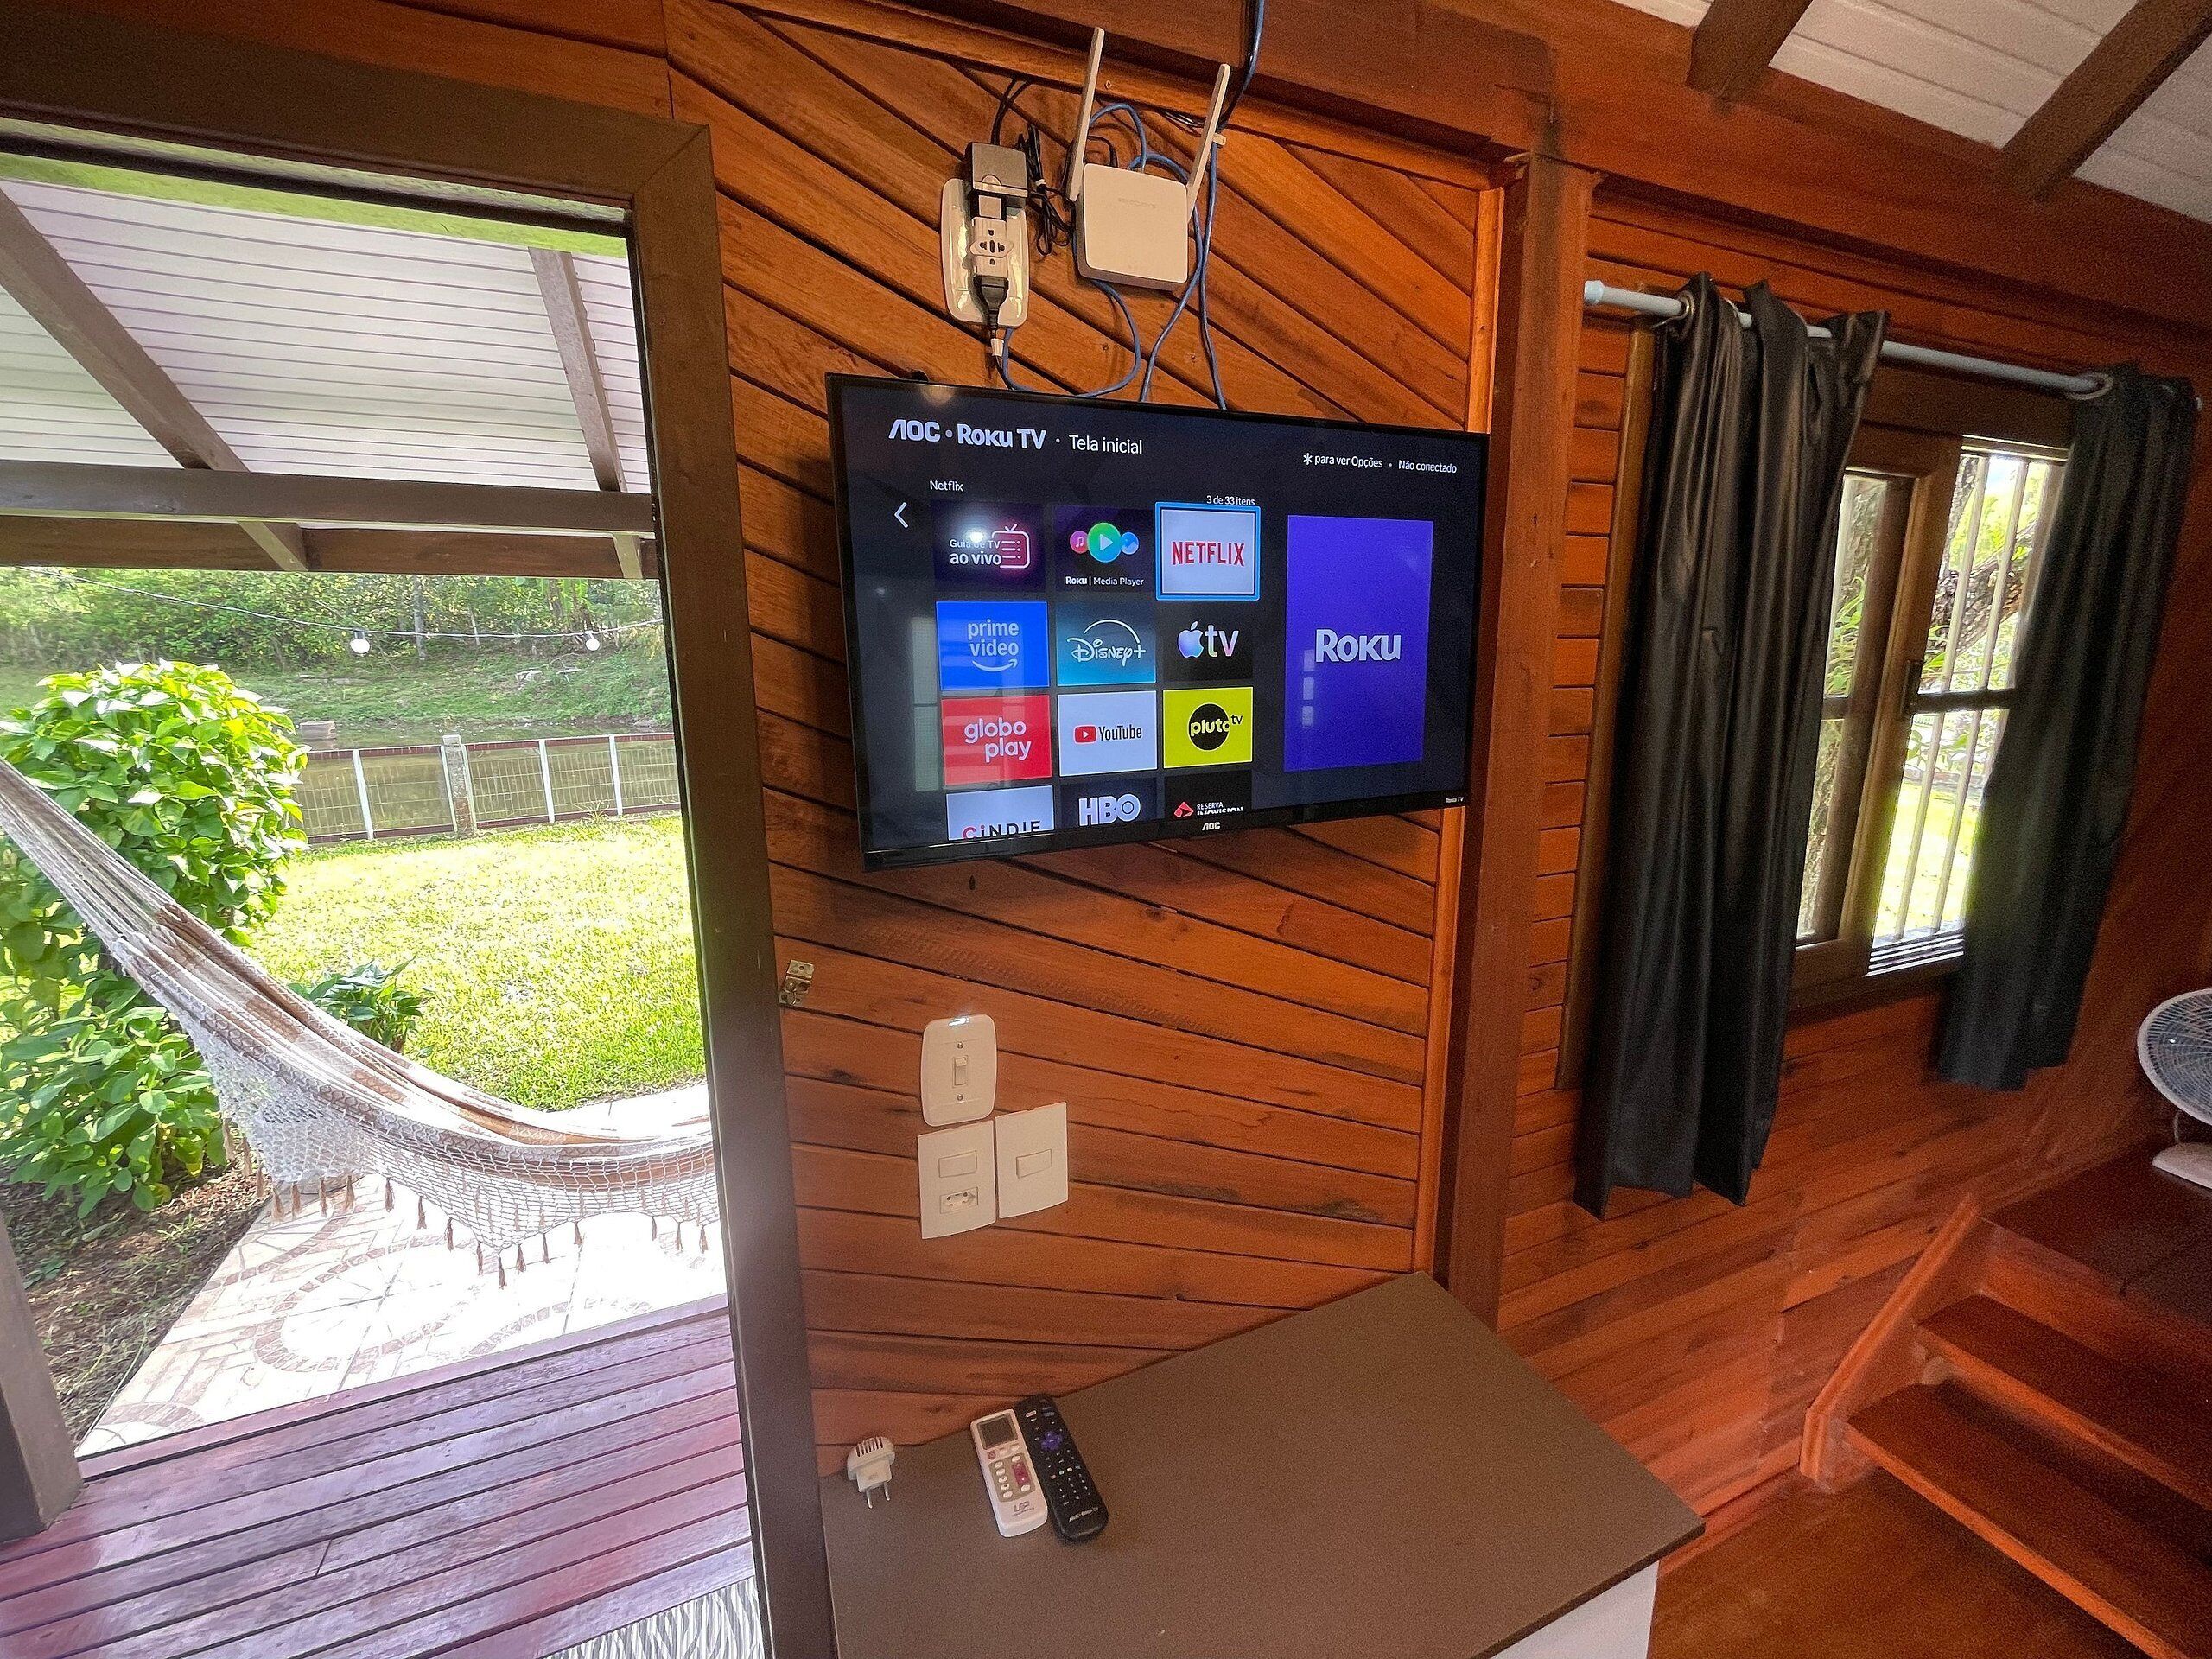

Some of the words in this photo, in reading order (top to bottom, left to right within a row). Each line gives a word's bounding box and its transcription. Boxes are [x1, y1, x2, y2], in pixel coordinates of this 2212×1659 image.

[957, 423, 1013, 448] Roku
[1016, 428, 1047, 449] TV
[1069, 434, 1098, 452] Tela
[1103, 436, 1142, 454] inicial
[1314, 455, 1334, 465] para
[1351, 455, 1382, 468] Opções
[1398, 460, 1414, 470] Não
[1416, 462, 1457, 473] conectado
[930, 480, 963, 492] Netflix
[1206, 495, 1212, 504] 3
[1213, 495, 1224, 505] de
[1224, 496, 1236, 505] 33
[1236, 497, 1255, 505] itens
[988, 540, 1001, 549] TV
[1172, 541, 1245, 566] NETFLIX
[950, 553, 969, 564] ao
[971, 550, 1002, 565] vivo
[1065, 576, 1088, 585] Roku
[1119, 577, 1144, 586] Player
[967, 619, 1019, 639] prime
[969, 640, 1019, 657] video
[1205, 624, 1239, 658] tv
[1315, 629, 1402, 663] Roku
[963, 717, 1027, 744] globo
[1098, 725, 1142, 741] YouTube
[1190, 719, 1230, 737] pluto
[1231, 714, 1243, 727] tv
[985, 738, 1032, 763] play
[1078, 793, 1141, 826] HBO
[1197, 801, 1224, 810] RESERVA
[1202, 822, 1220, 831] AOC
